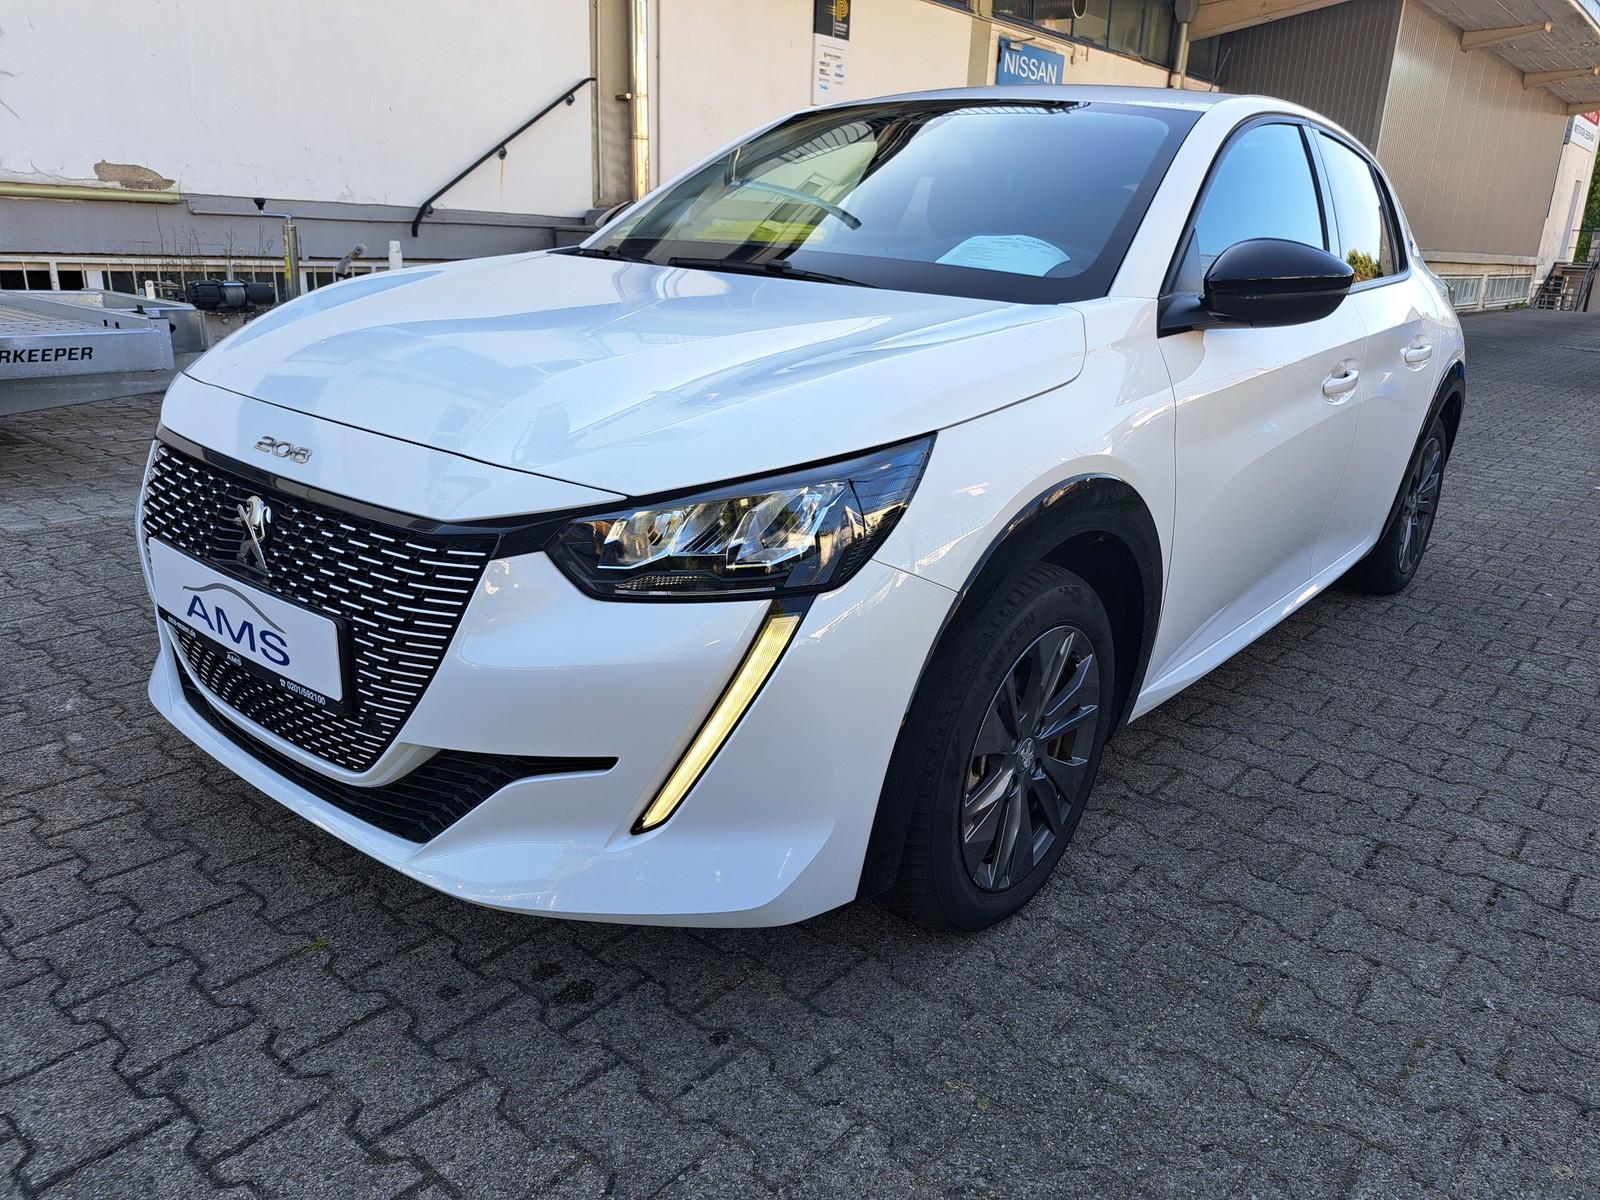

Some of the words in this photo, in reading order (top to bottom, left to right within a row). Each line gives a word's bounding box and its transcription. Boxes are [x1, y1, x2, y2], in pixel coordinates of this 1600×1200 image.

[1004, 51, 1057, 84] NISSAN
[0, 347, 93, 363] RKEEPER
[254, 436, 312, 464] 208
[187, 595, 290, 666] AMS
[985, 610, 1035, 682] NEXEN
[286, 680, 326, 705] 0201/592100
